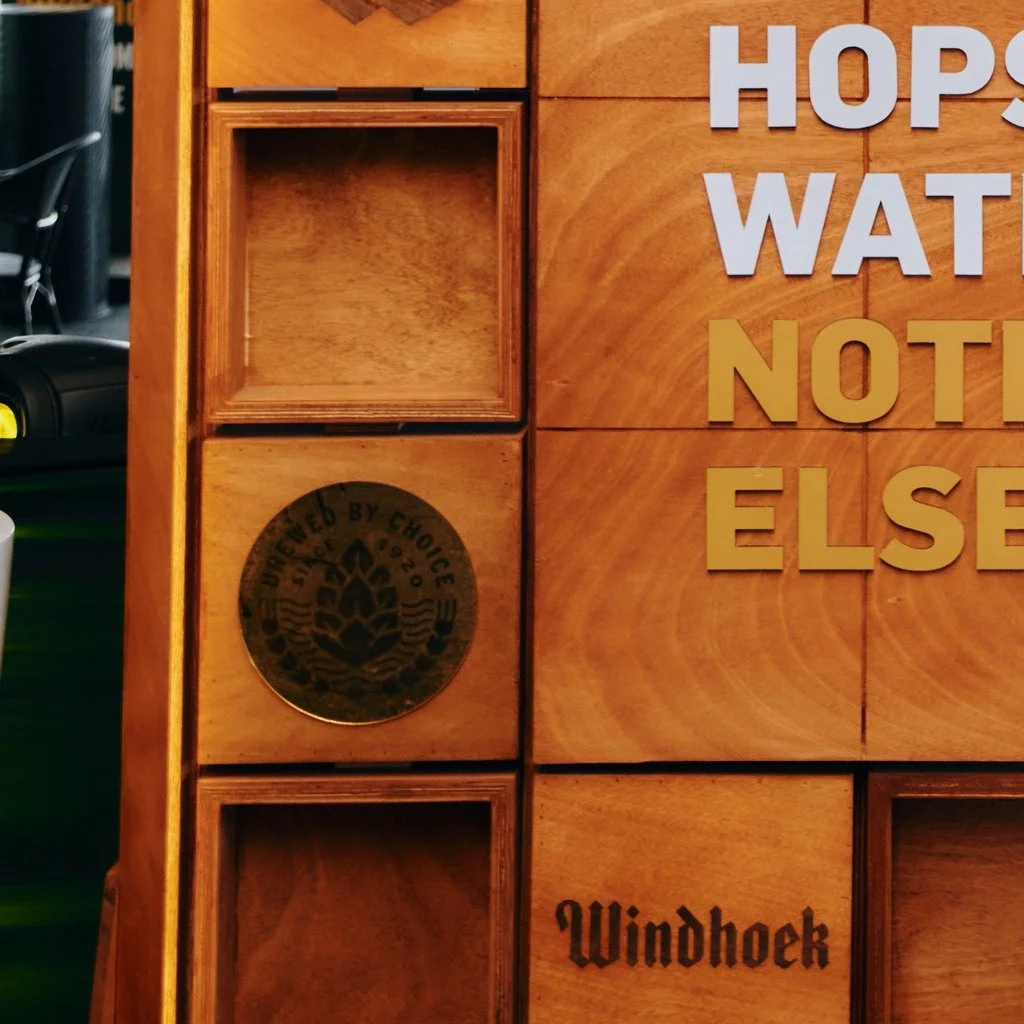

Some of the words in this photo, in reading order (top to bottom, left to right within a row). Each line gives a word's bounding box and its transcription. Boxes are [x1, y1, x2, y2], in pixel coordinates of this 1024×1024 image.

[349, 502, 379, 522] BY
[389, 511, 456, 589] CHOICE
[555, 899, 830, 969] Windhoek
